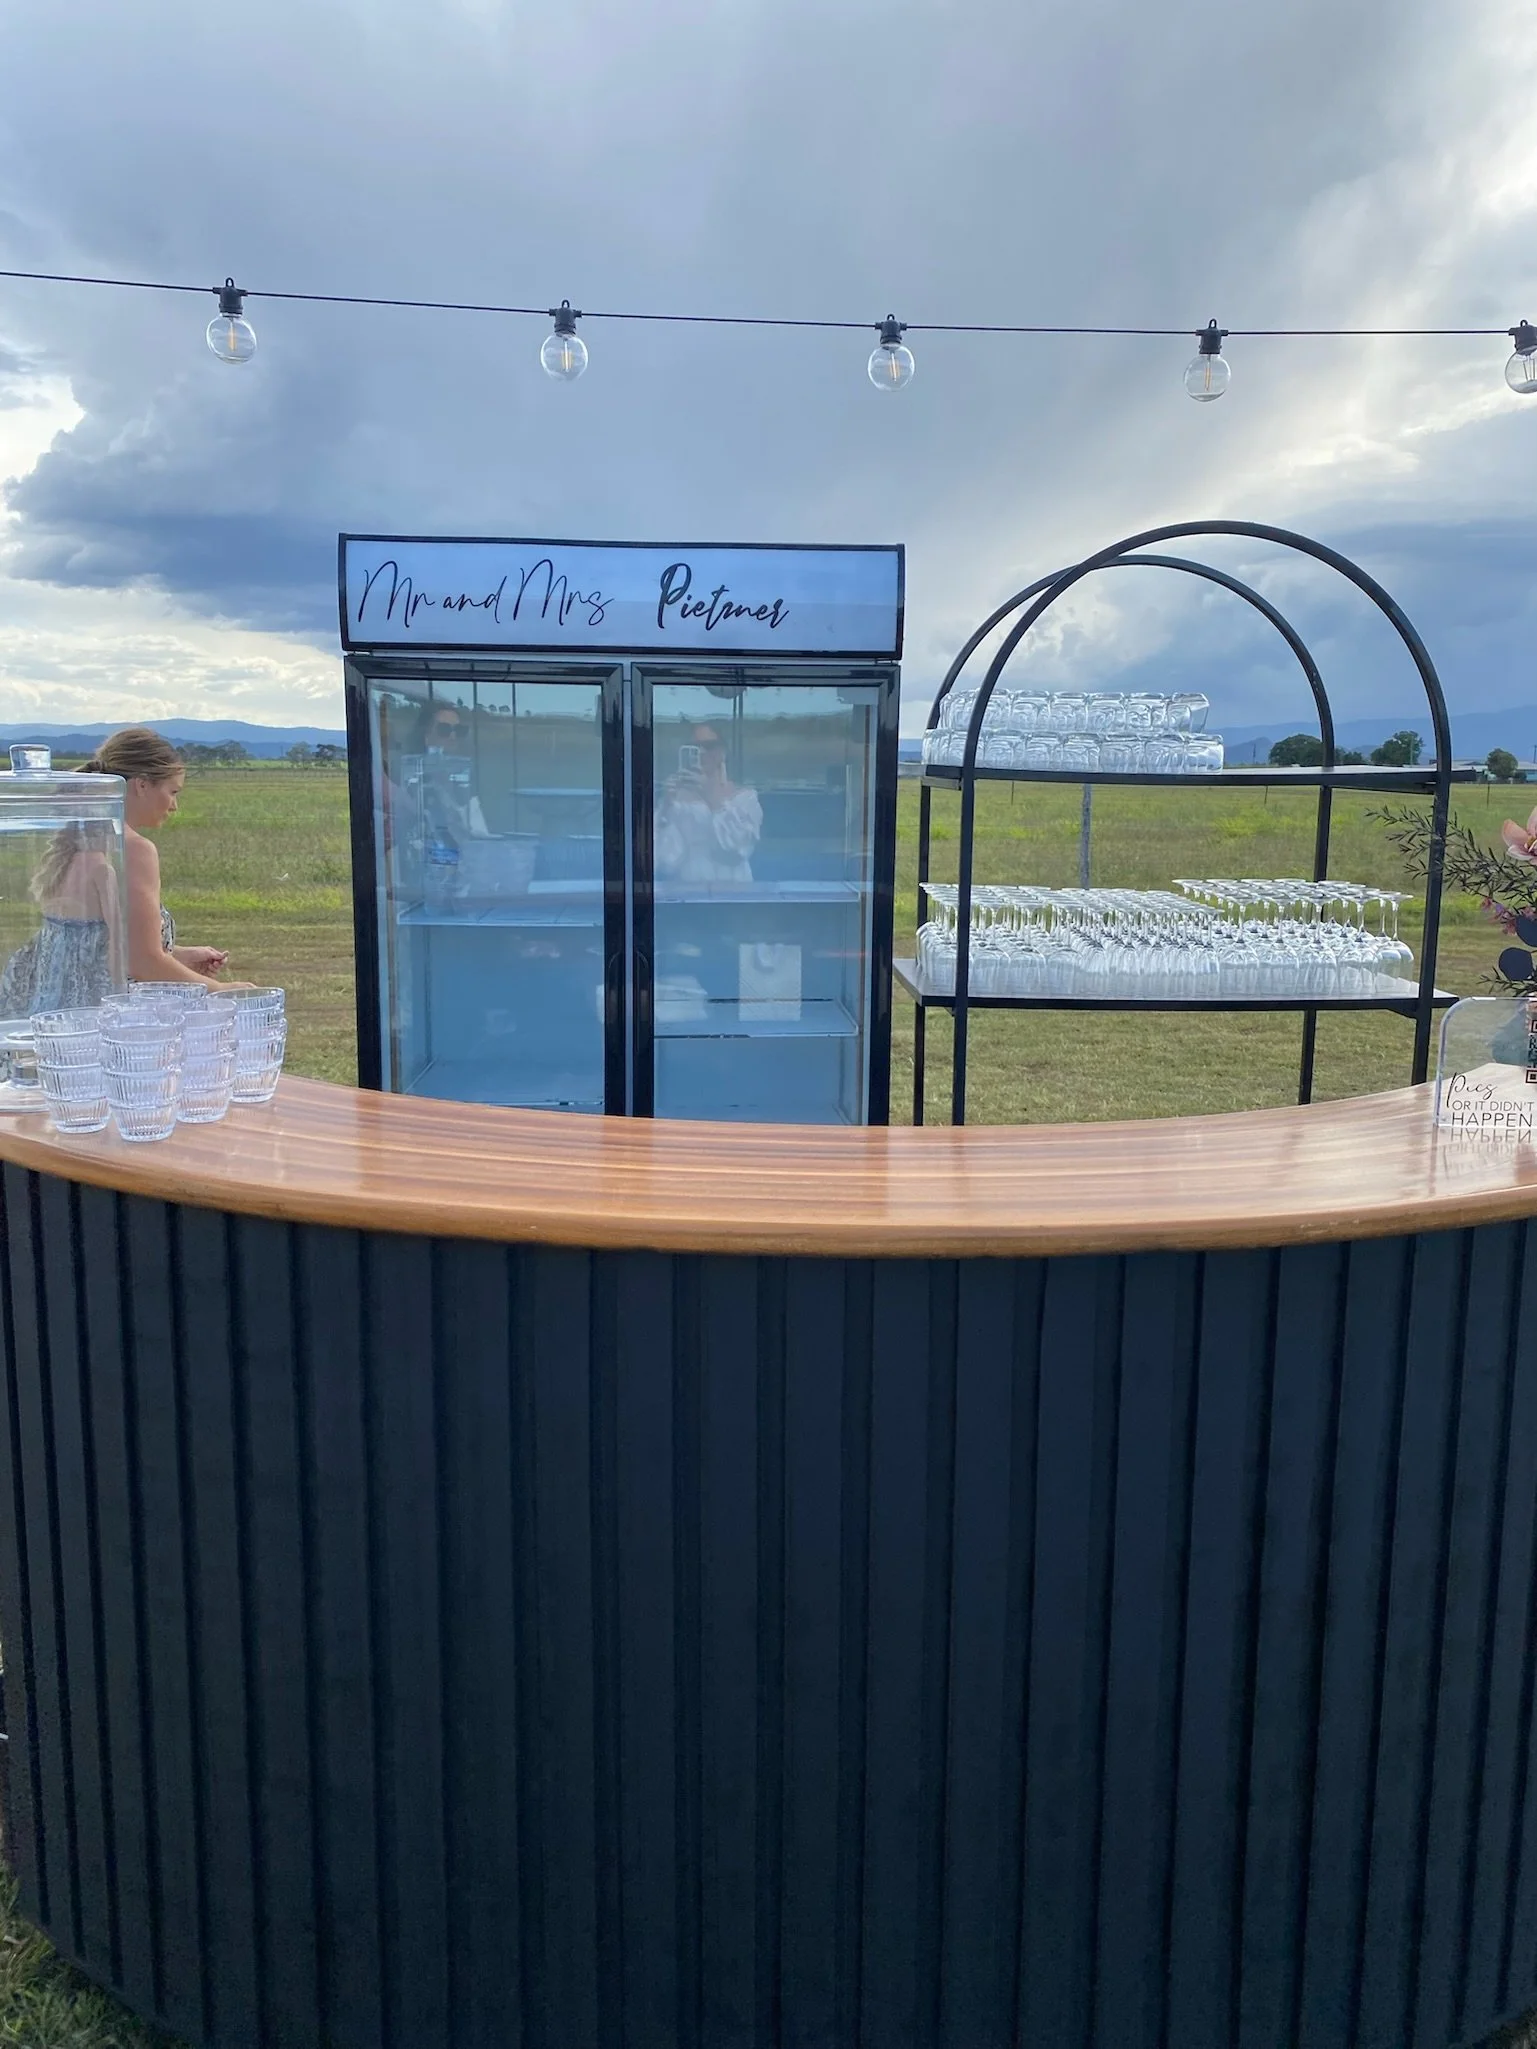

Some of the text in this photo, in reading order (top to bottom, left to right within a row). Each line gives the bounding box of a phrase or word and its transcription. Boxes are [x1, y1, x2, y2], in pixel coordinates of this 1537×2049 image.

[358, 560, 435, 628] Mr
[442, 575, 507, 624] and
[513, 558, 615, 626] Mrs
[1446, 1072, 1498, 1108] Pics
[1452, 1100, 1535, 1112] OR IT DIDN'T
[1452, 1112, 1533, 1127] HAPPEN
